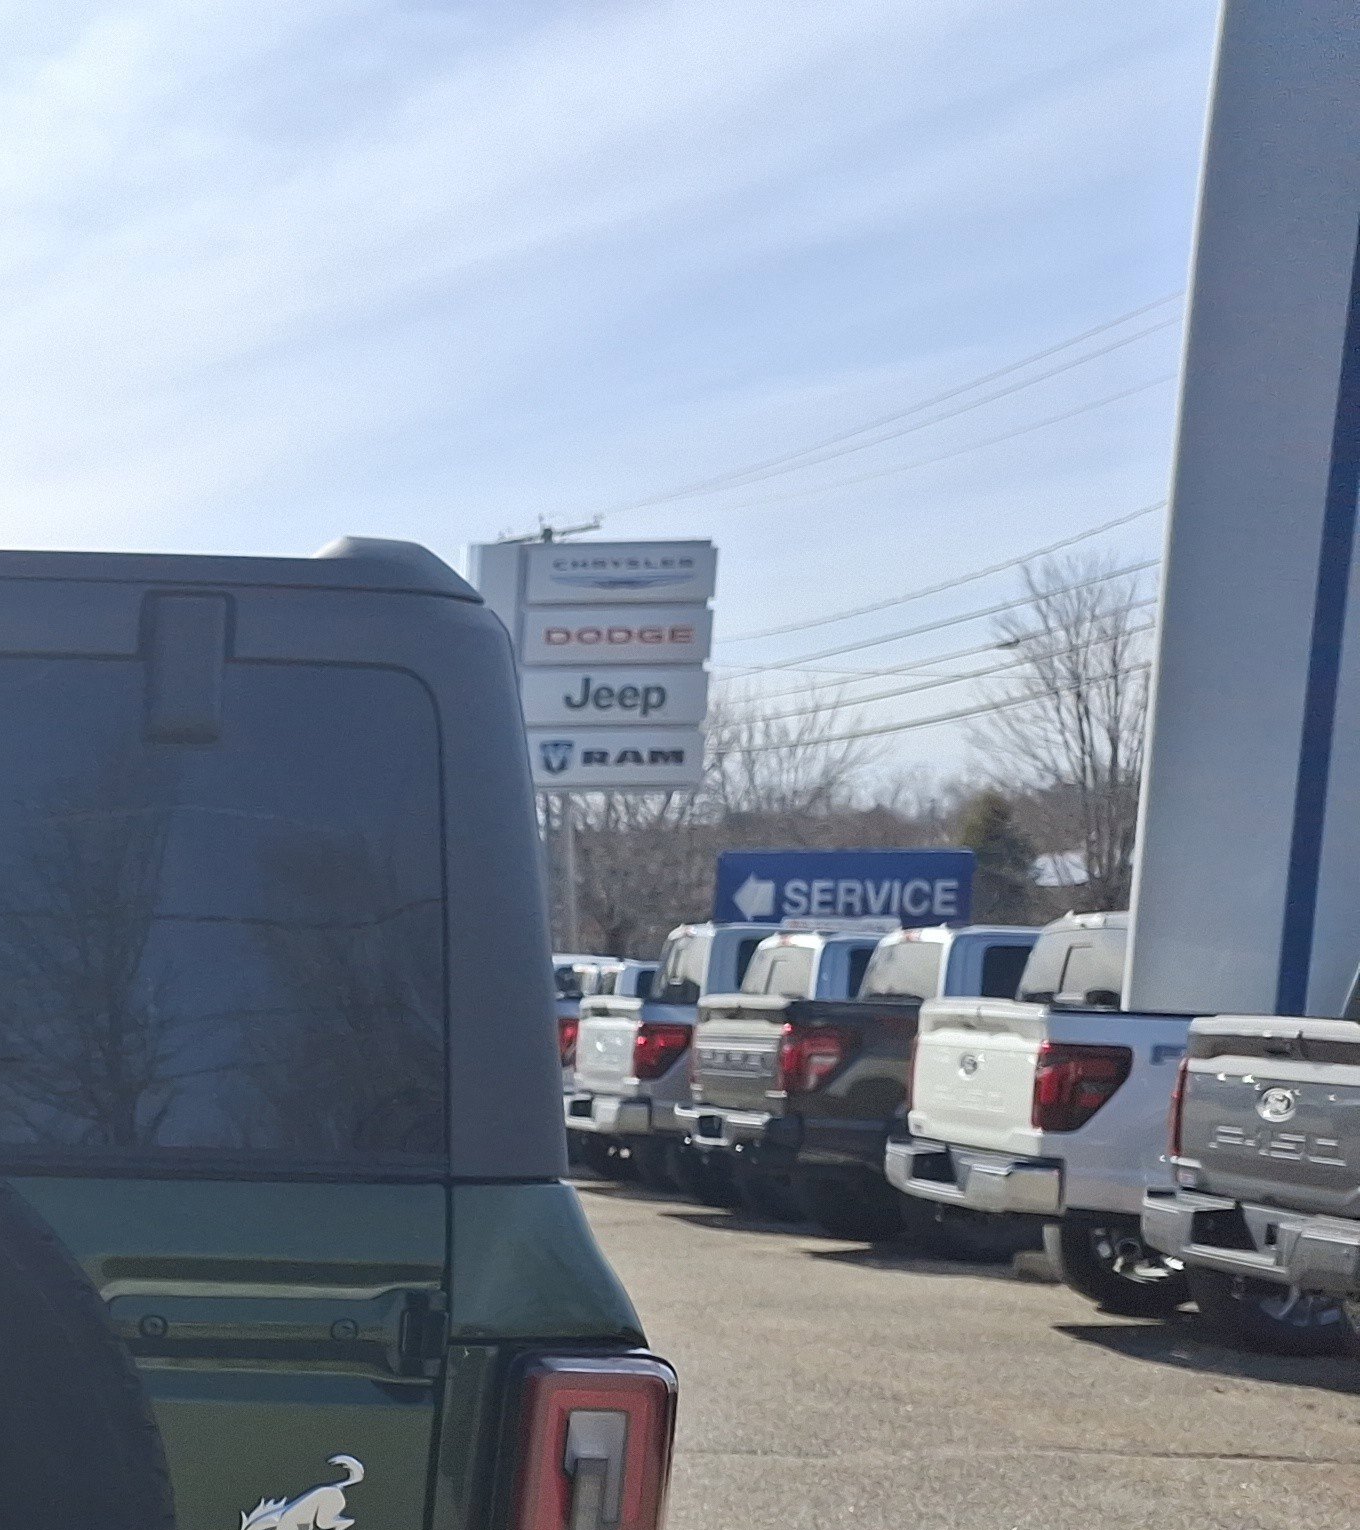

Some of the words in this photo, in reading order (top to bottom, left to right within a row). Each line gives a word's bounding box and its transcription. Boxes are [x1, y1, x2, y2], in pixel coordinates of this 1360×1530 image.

[544, 626, 694, 646] DODGE
[564, 676, 667, 716] Jeep
[582, 749, 685, 766] RAM
[783, 878, 960, 917] SERVICE
